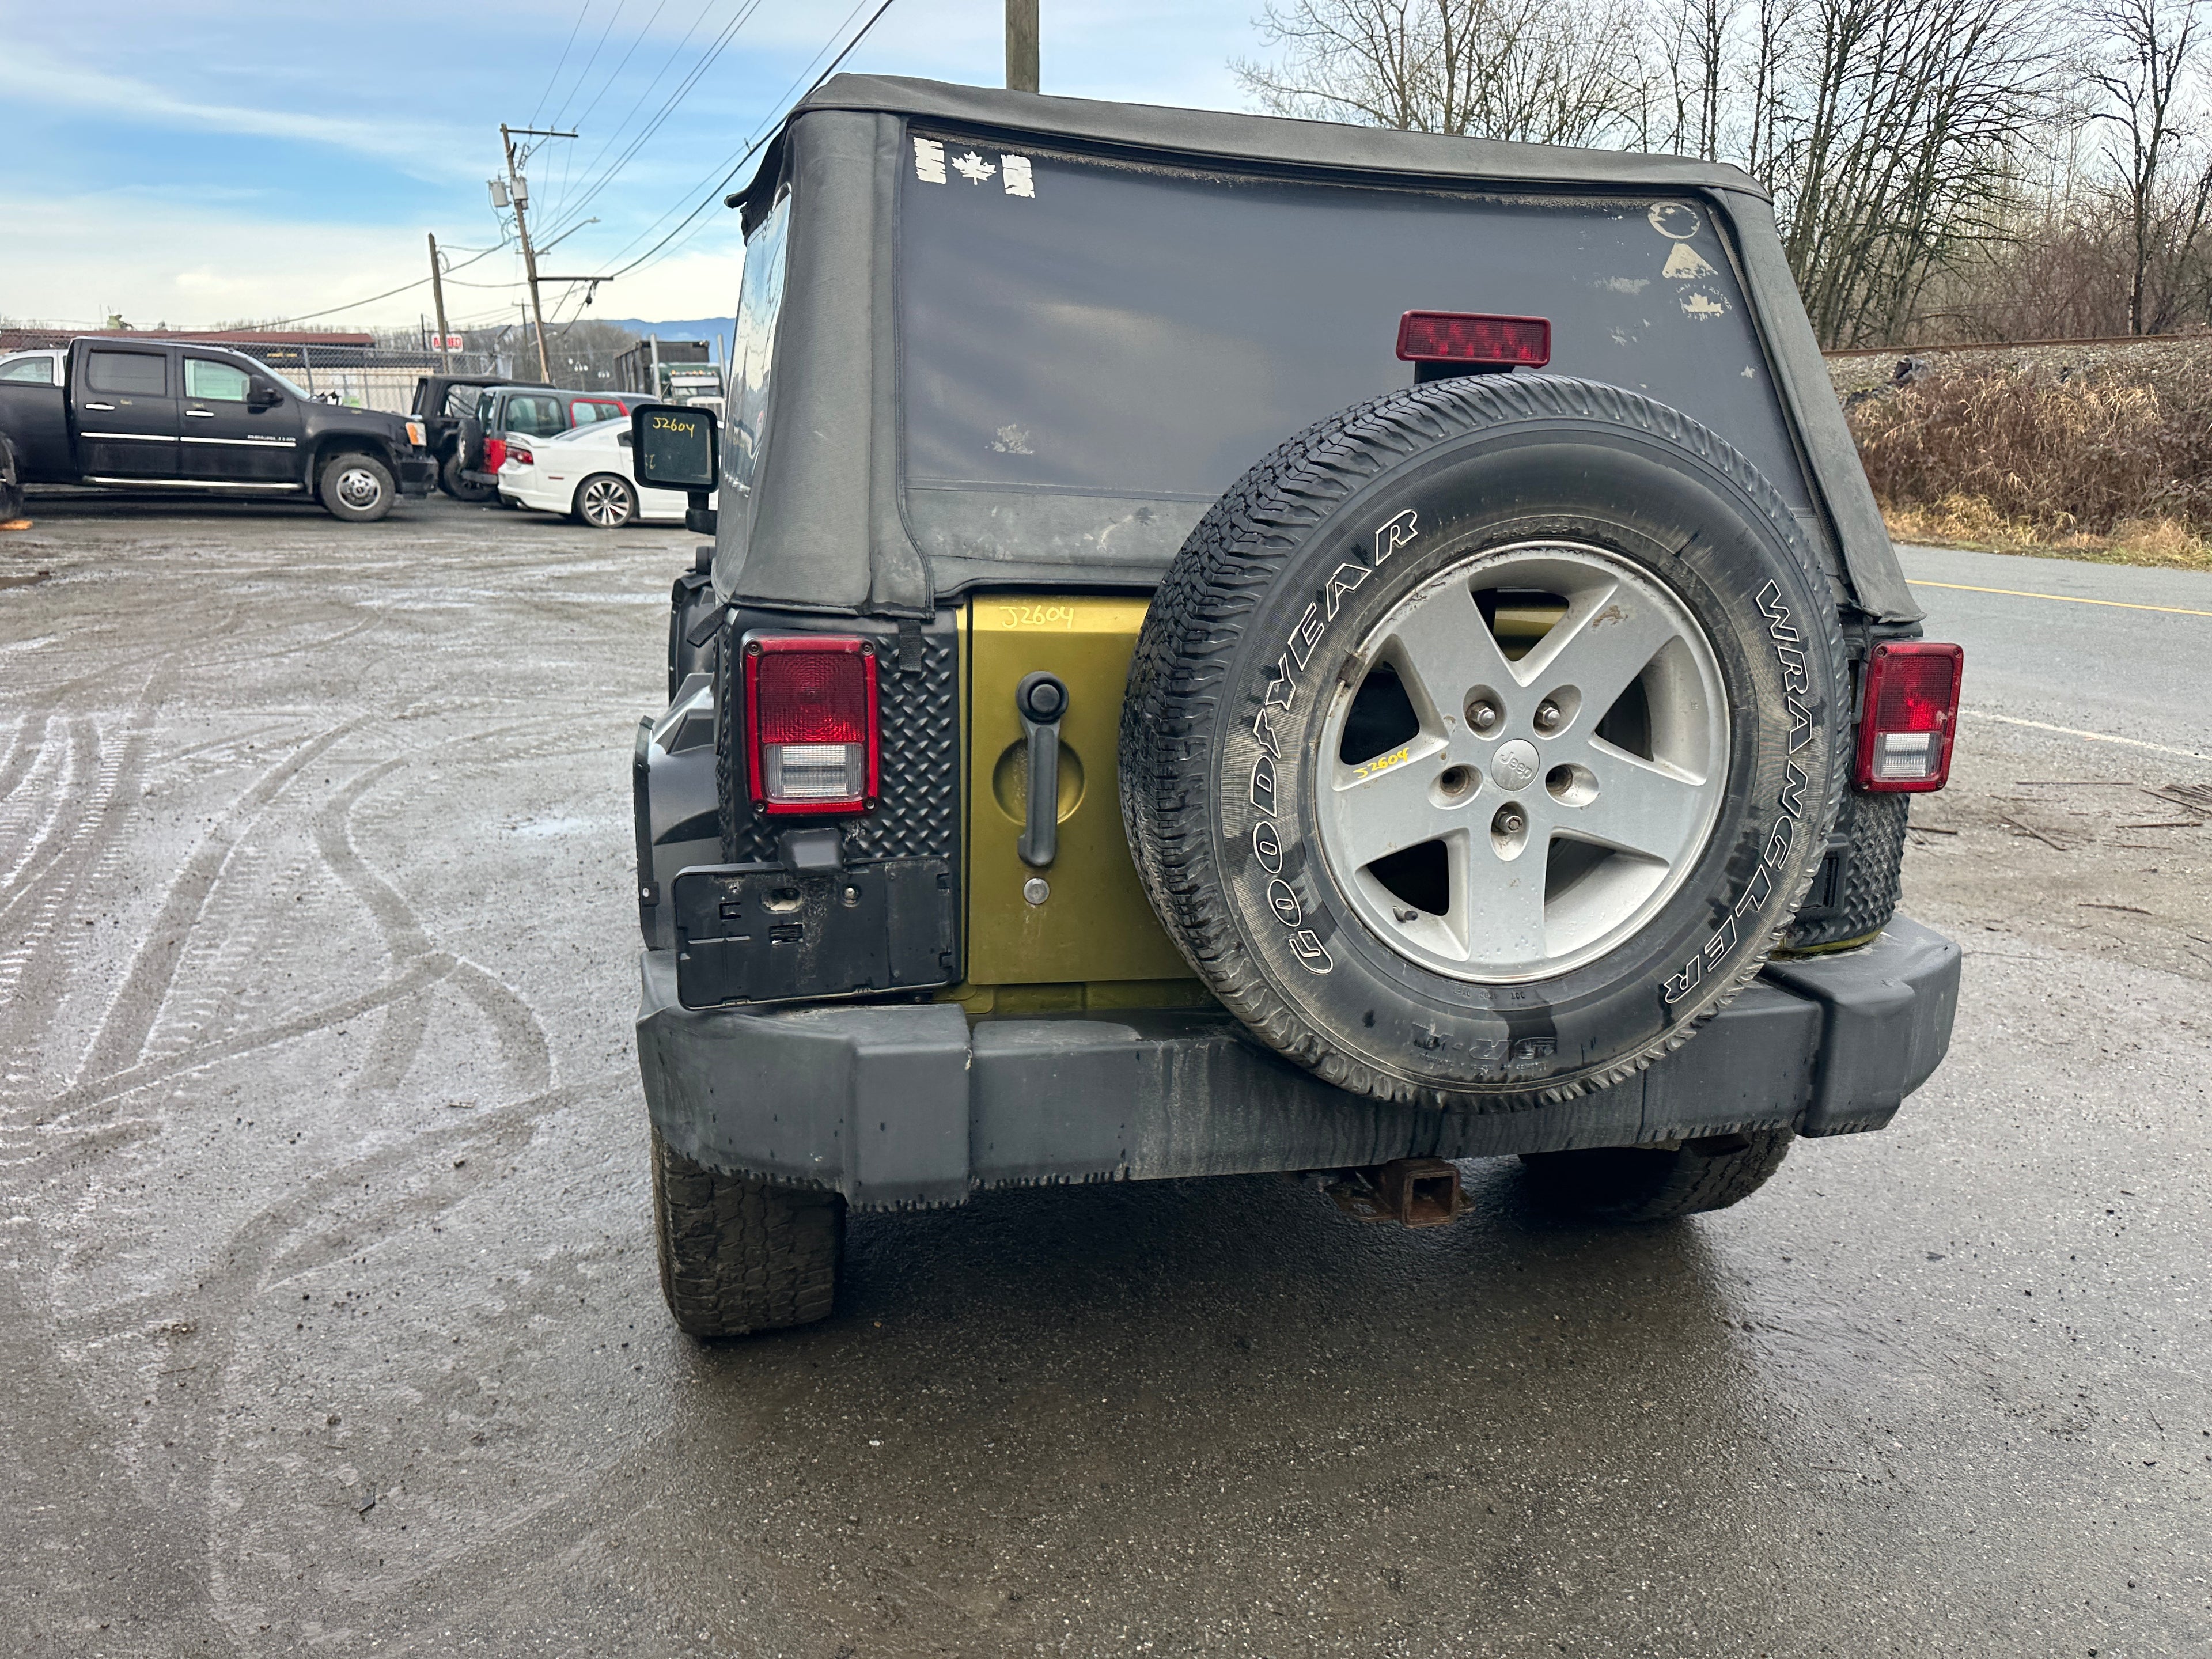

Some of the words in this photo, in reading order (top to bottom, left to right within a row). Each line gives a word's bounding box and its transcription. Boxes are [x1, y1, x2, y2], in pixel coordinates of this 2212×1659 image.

[653, 417, 695, 438] J2604
[999, 605, 1074, 629] J2604
[1249, 508, 1419, 975] GOODYEAR
[1499, 751, 1532, 779] Jeep
[1662, 579, 1813, 1004] WRANGLER
